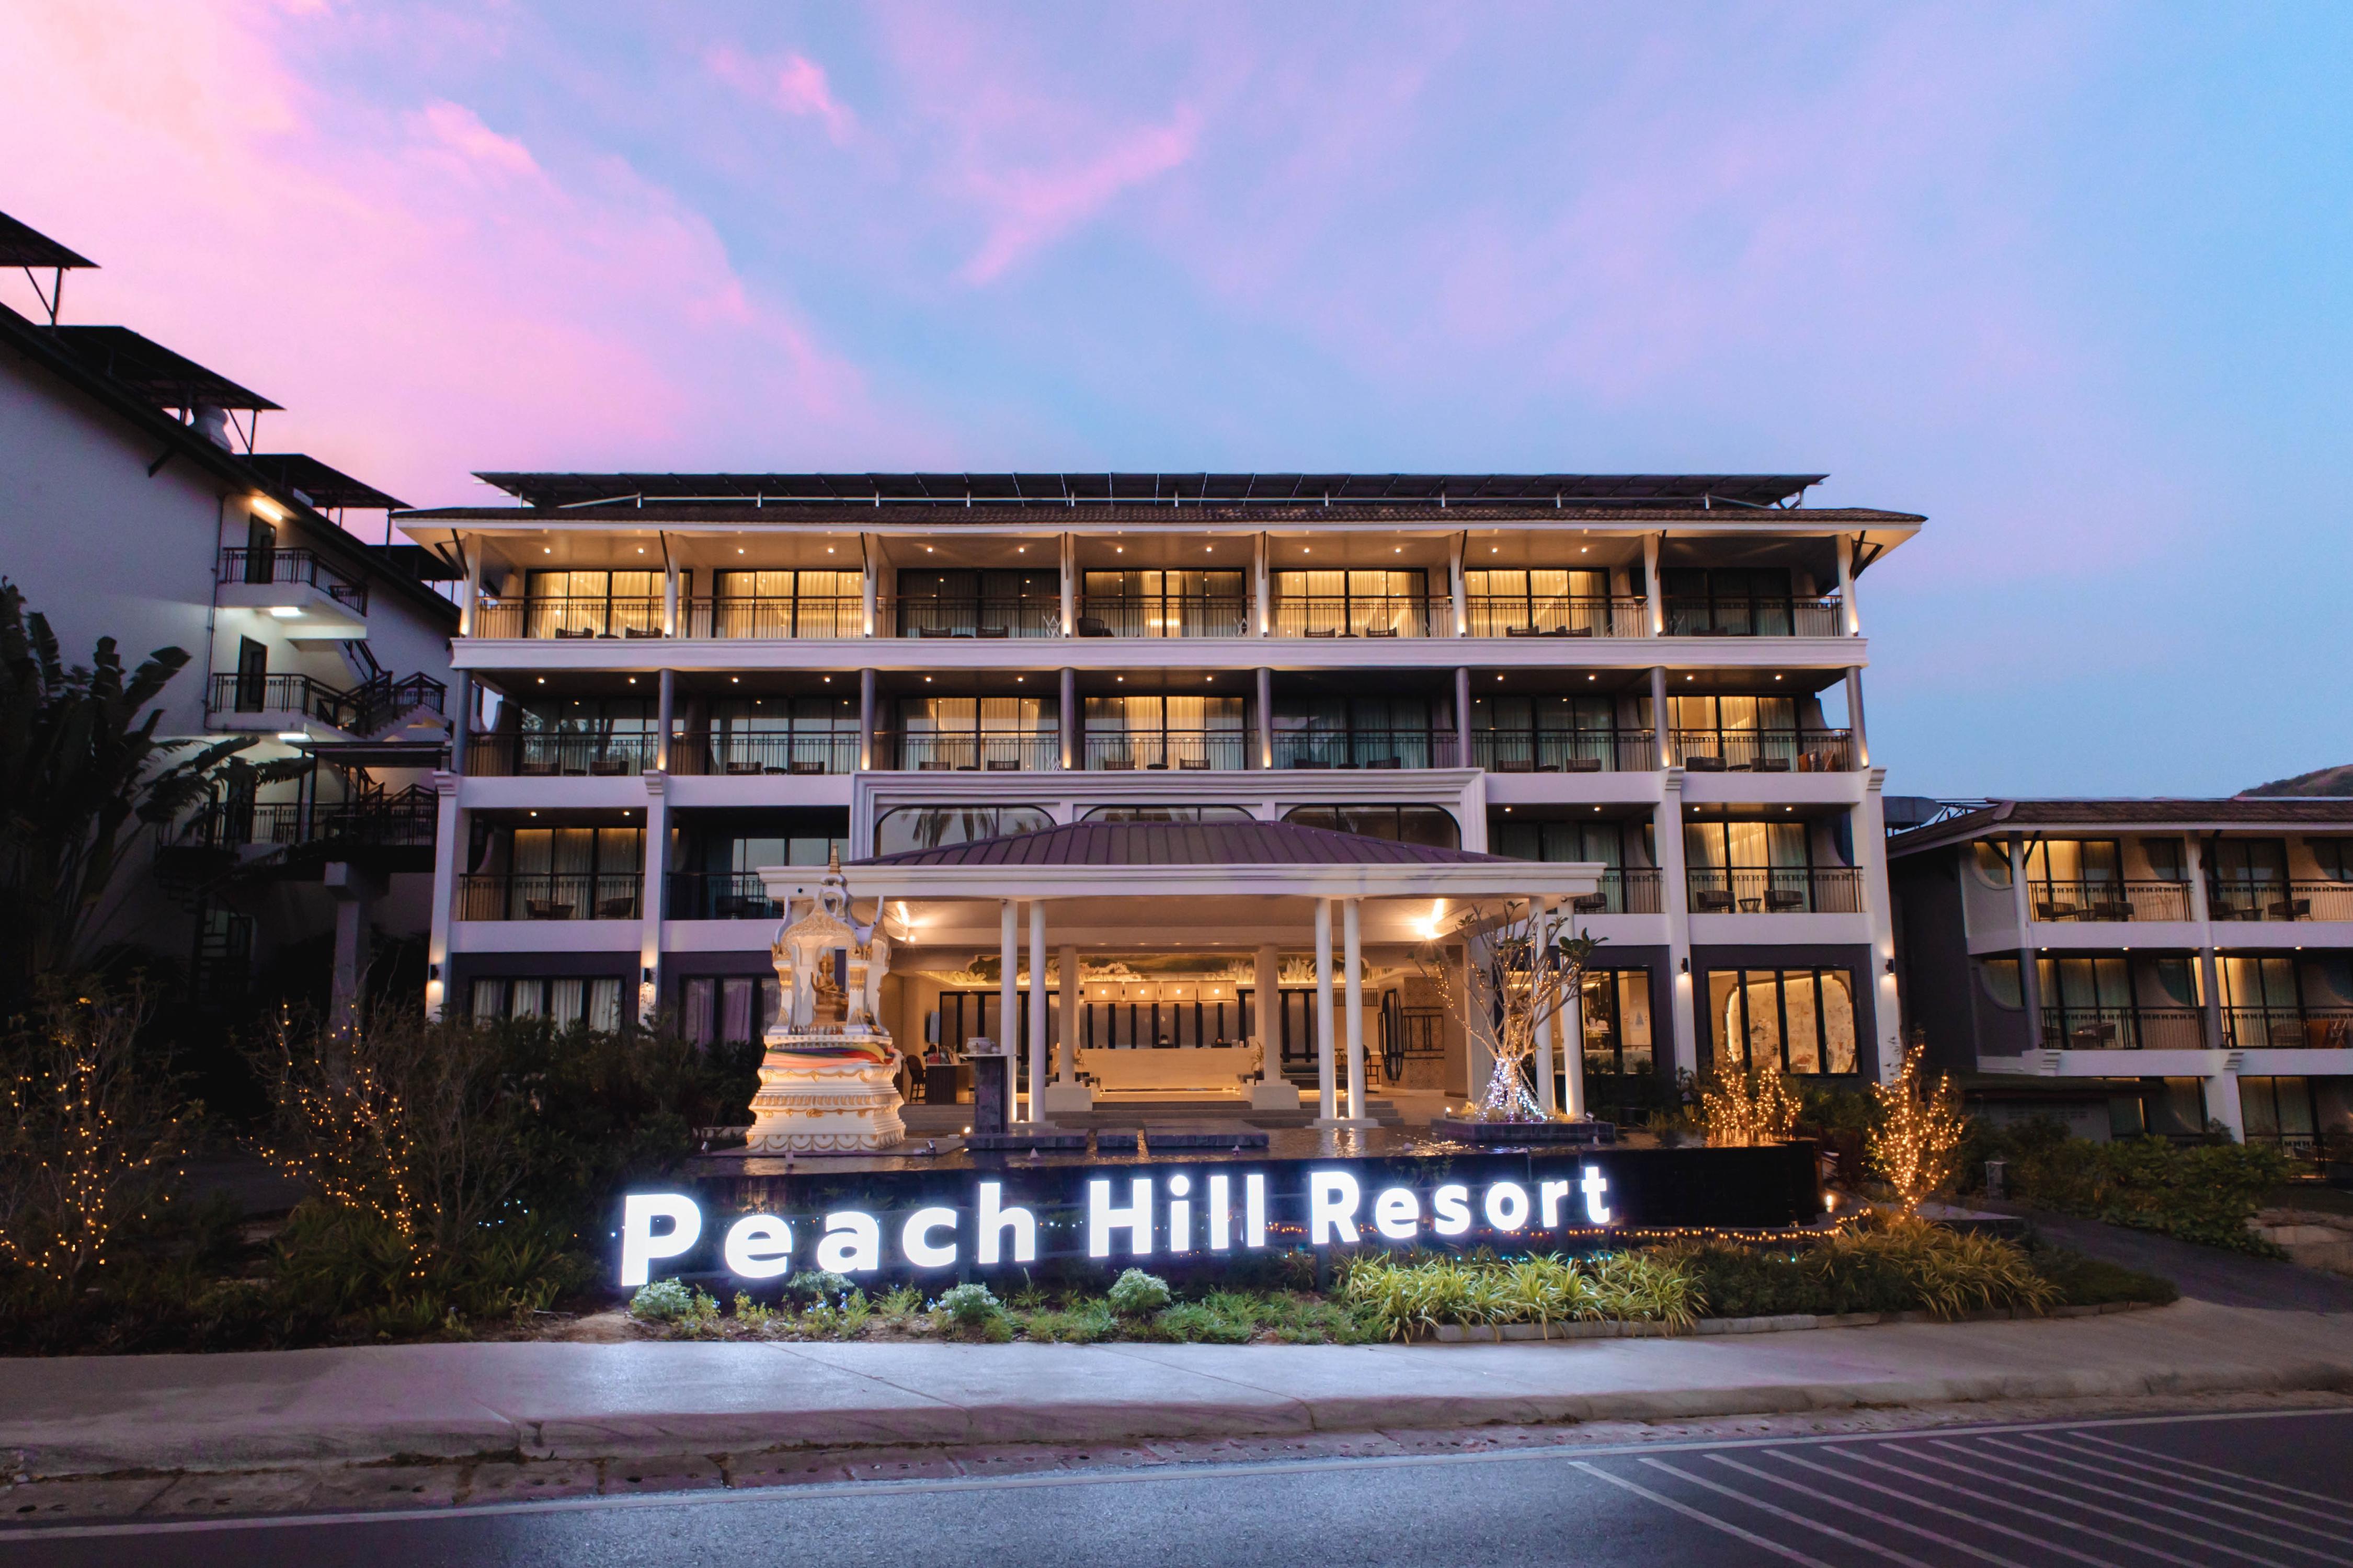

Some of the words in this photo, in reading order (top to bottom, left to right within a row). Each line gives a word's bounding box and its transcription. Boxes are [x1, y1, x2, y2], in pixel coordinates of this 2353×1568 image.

[621, 1182, 1036, 1287] Peach
[1089, 1174, 1265, 1257] Hill
[1310, 1166, 1610, 1244] Resort
